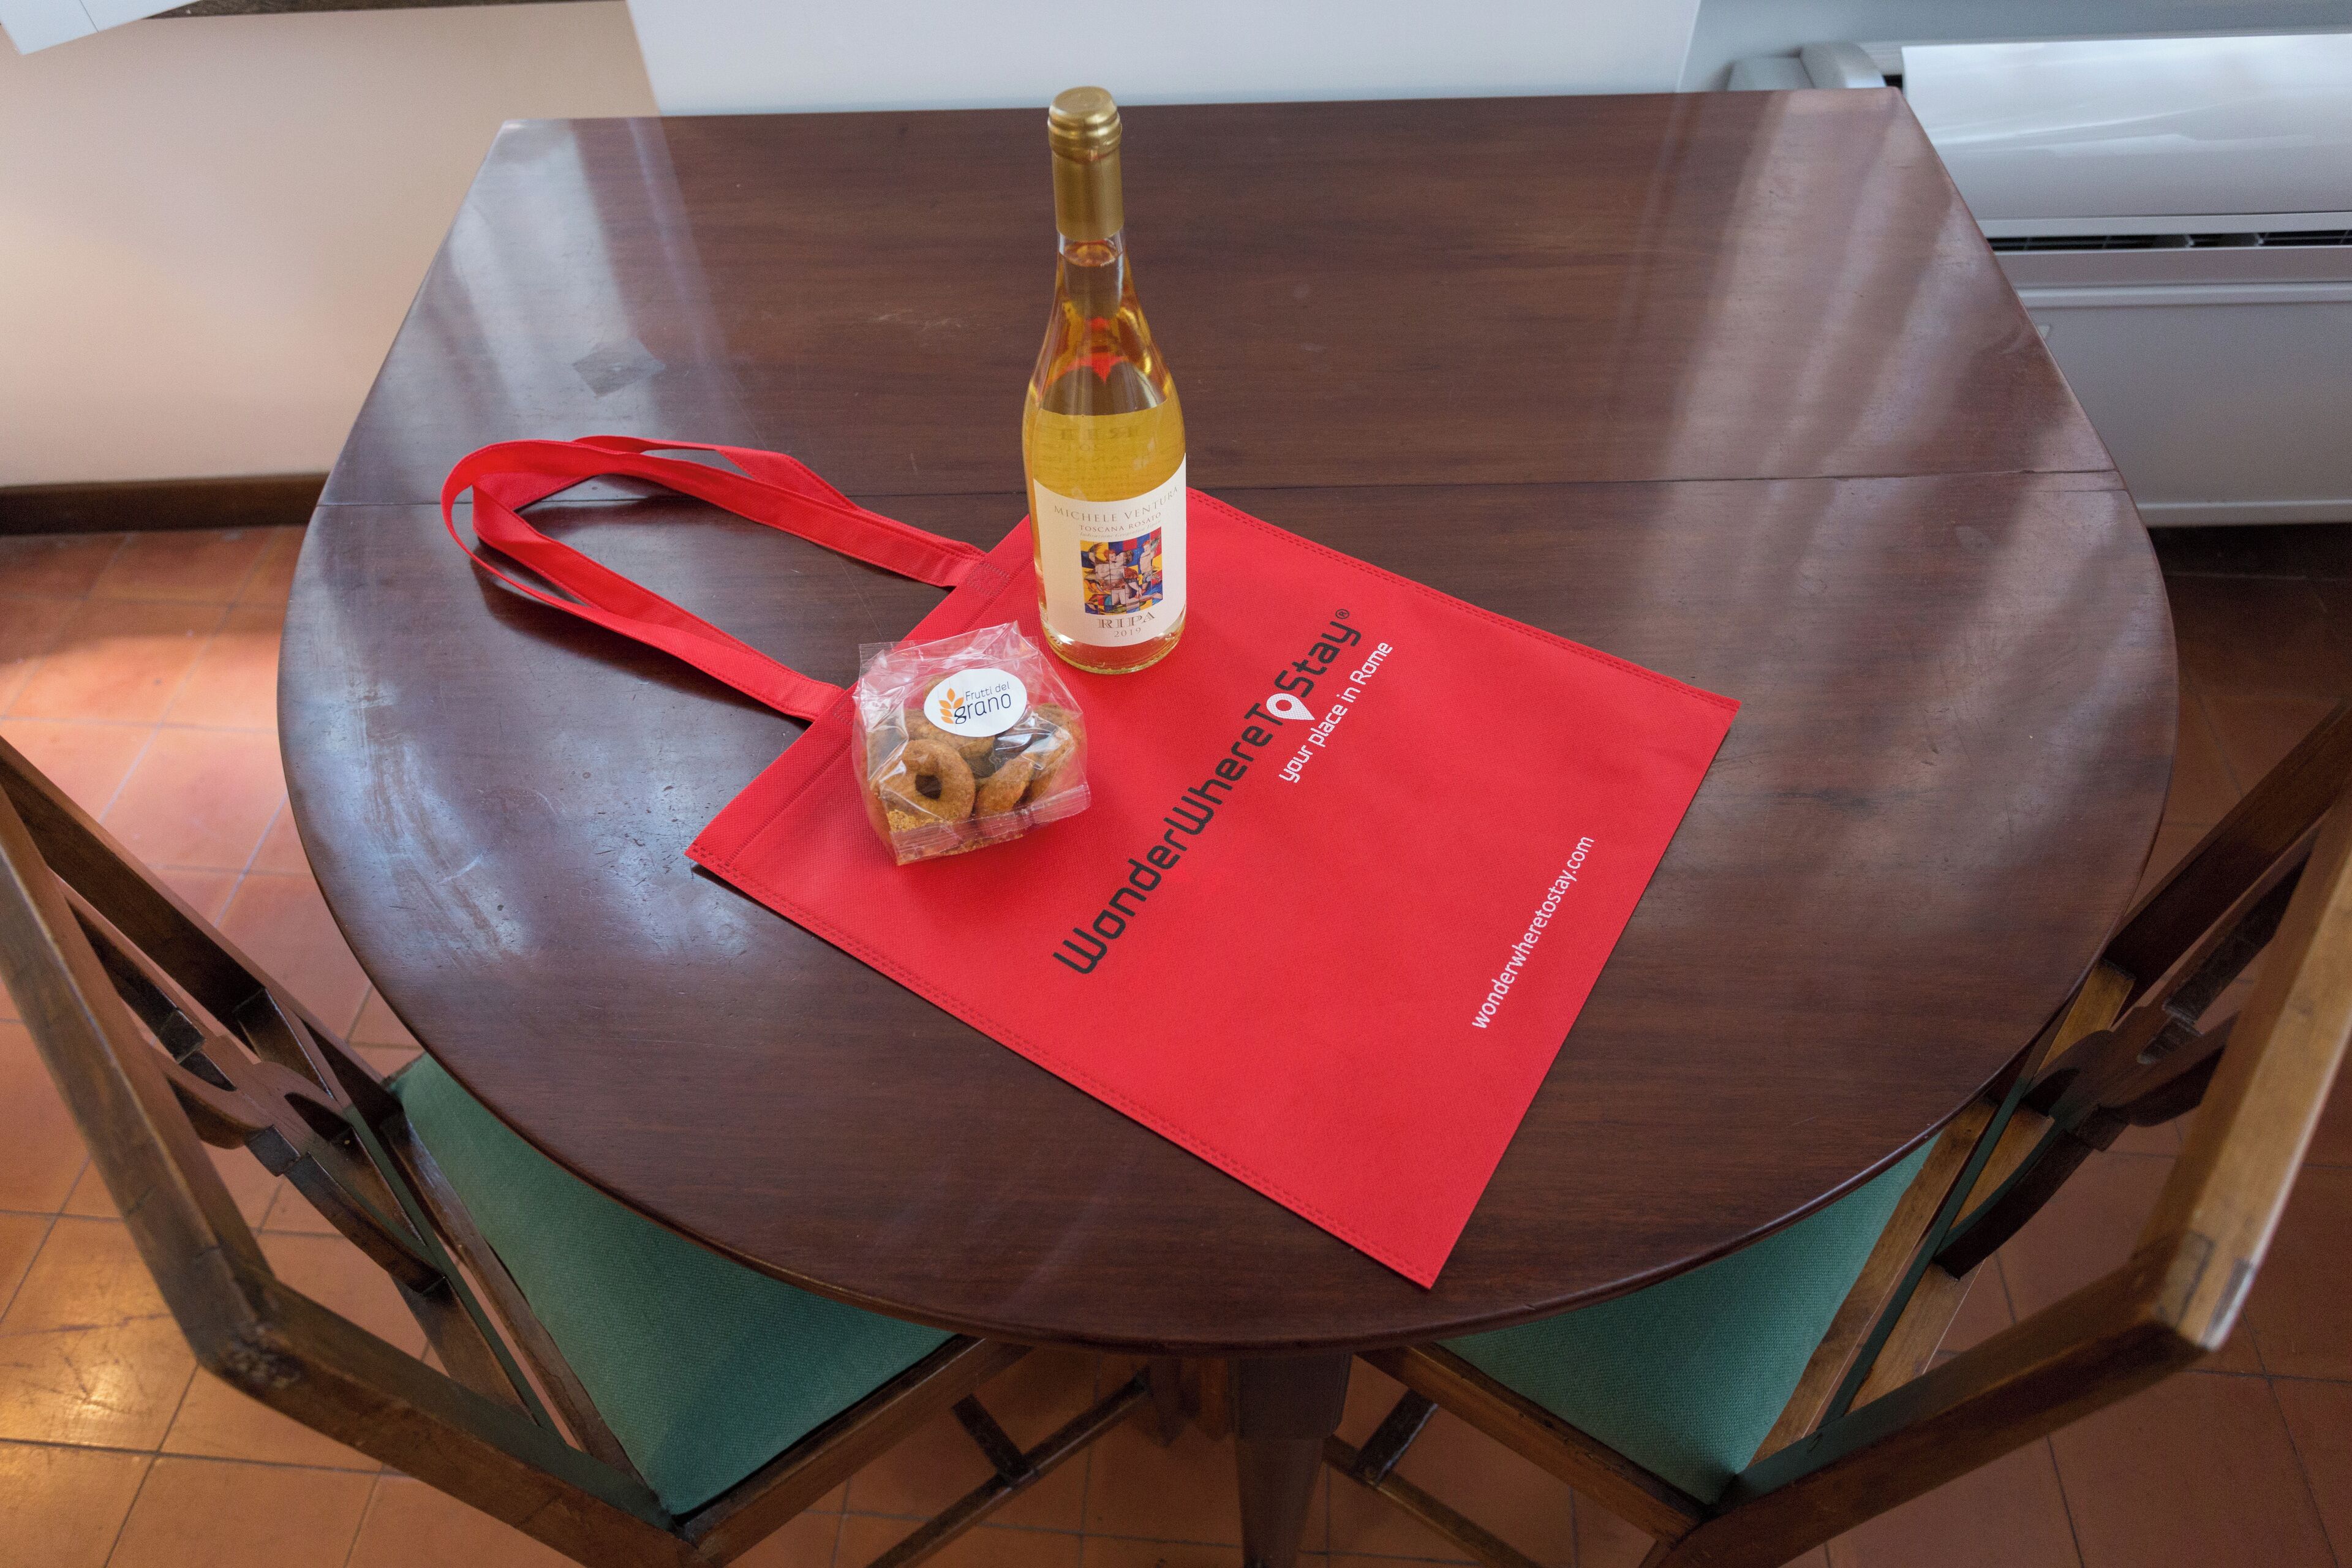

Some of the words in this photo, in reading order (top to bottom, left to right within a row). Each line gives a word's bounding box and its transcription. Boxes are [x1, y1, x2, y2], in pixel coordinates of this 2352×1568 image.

[1054, 505, 1117, 522] MICHELE
[1125, 486, 1178, 519] VENTURA
[1129, 512, 1162, 529] ROSATO
[1098, 612, 1156, 628] RIPA
[1114, 627, 1141, 638] 2019
[965, 686, 993, 701] Frutti
[995, 681, 1010, 693] del
[954, 693, 1011, 725] grano
[1279, 745, 1313, 783] your
[1308, 704, 1348, 748] place
[1336, 687, 1361, 703] in
[1349, 643, 1393, 685] Rome
[1472, 837, 1594, 1029] wonderwheretostay.com
